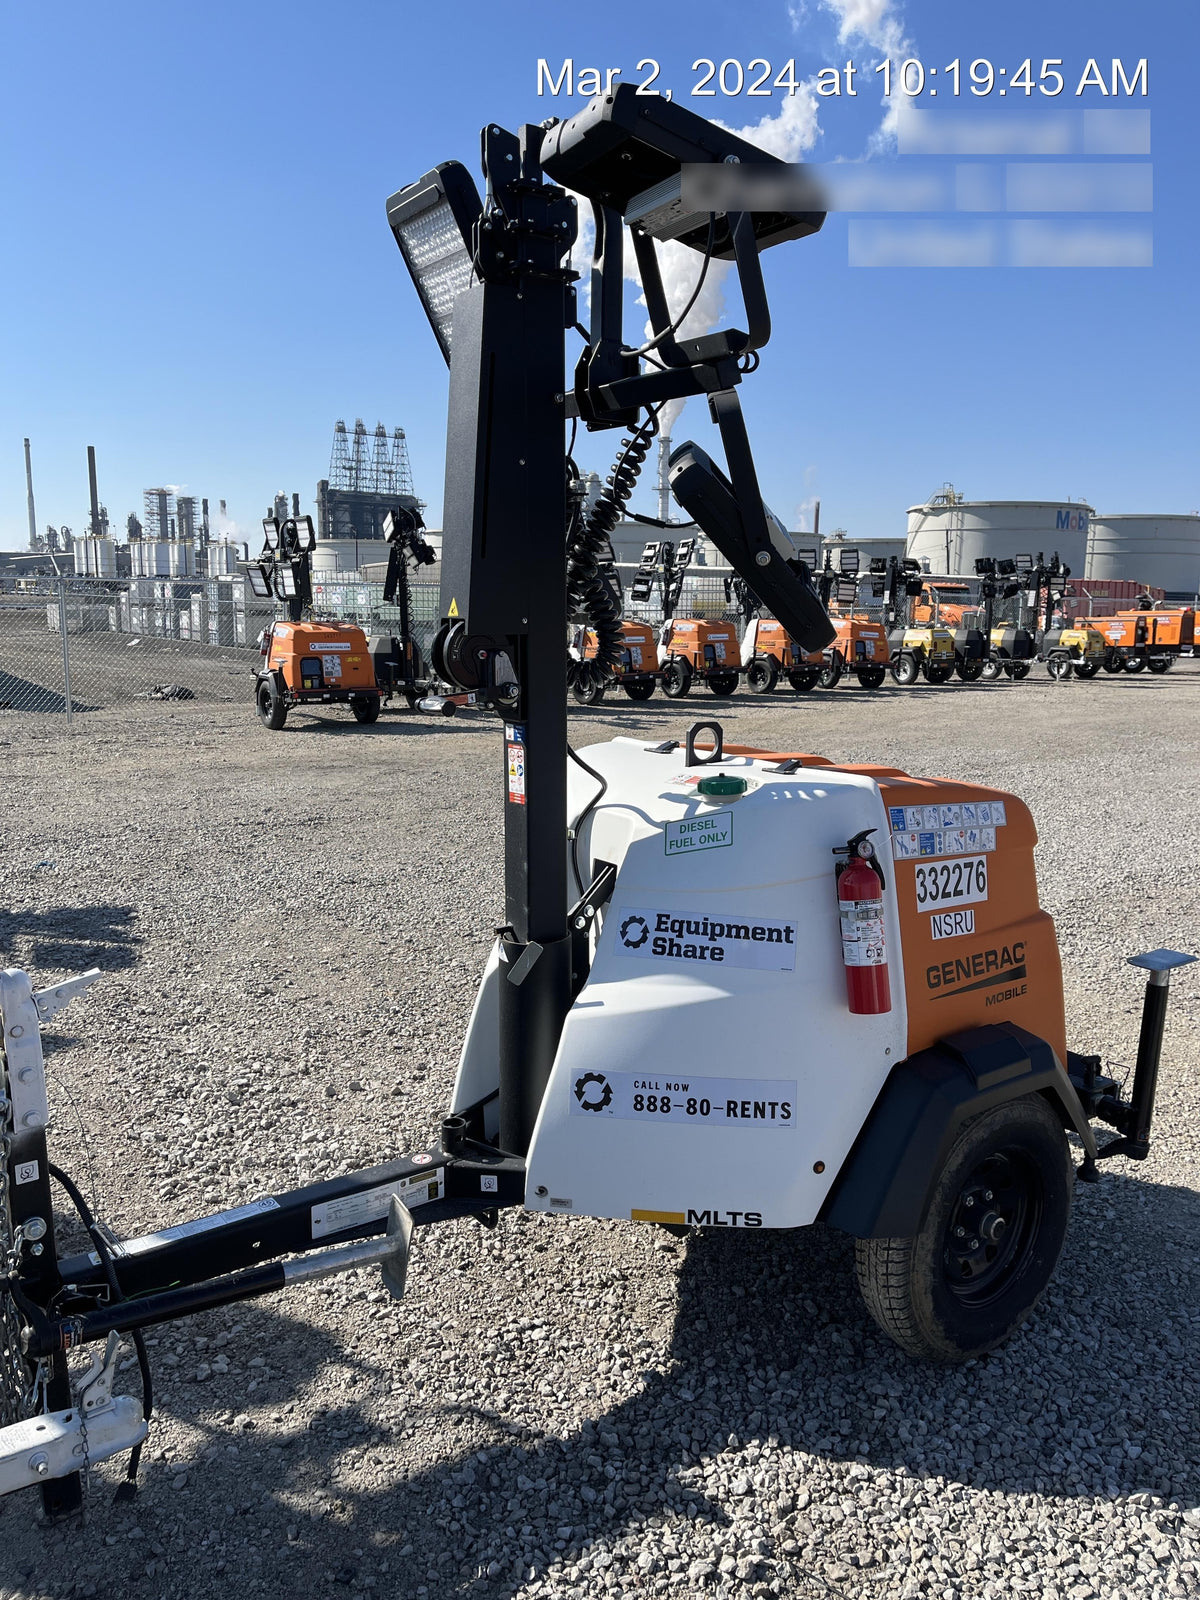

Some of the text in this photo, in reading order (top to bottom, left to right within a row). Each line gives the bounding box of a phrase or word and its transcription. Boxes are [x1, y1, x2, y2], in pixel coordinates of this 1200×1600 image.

[679, 820, 717, 834] DIESEL
[669, 831, 728, 850] FUEL ONLY
[916, 860, 986, 902] 332276
[654, 913, 795, 944] Equipment
[932, 912, 974, 938] NSRU
[652, 936, 725, 962] Share
[926, 942, 1026, 990] GENERAC
[985, 984, 1028, 1007] MOBILE
[633, 1080, 690, 1093] CALL NOW
[633, 1094, 793, 1120] 888-80-RENTS
[687, 1209, 763, 1227] MLTS
